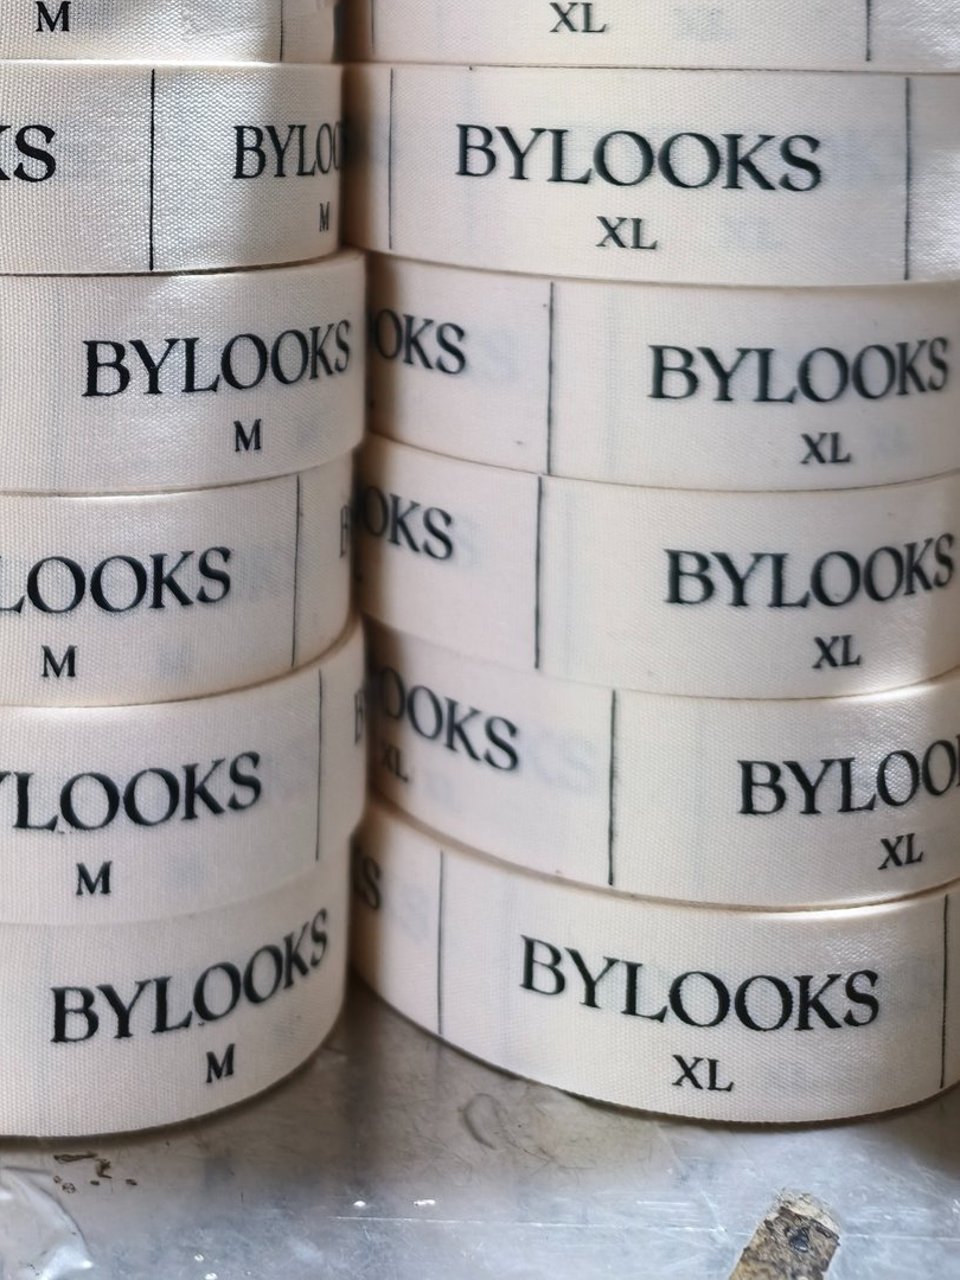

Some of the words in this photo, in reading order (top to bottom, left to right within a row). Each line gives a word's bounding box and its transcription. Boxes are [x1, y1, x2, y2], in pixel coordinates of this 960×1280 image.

[35, 1, 71, 32] M
[549, 1, 607, 33] XL
[456, 123, 822, 192] BYLOOKS
[596, 216, 658, 250] XL
[82, 319, 350, 398] BYLOOKS
[648, 336, 948, 403] BYLOOKS
[233, 419, 261, 452] M
[800, 432, 852, 465] XL
[664, 532, 955, 609] BYLOOKS
[41, 645, 77, 678] M
[812, 635, 862, 669] XL
[738, 734, 960, 815] BYLOO
[878, 833, 924, 870] XL
[75, 860, 112, 895] M
[49, 908, 329, 1044] BYLOOKS
[520, 935, 879, 1032] BYLOOKS
[205, 1044, 236, 1084] M
[672, 1055, 734, 1092] XL
